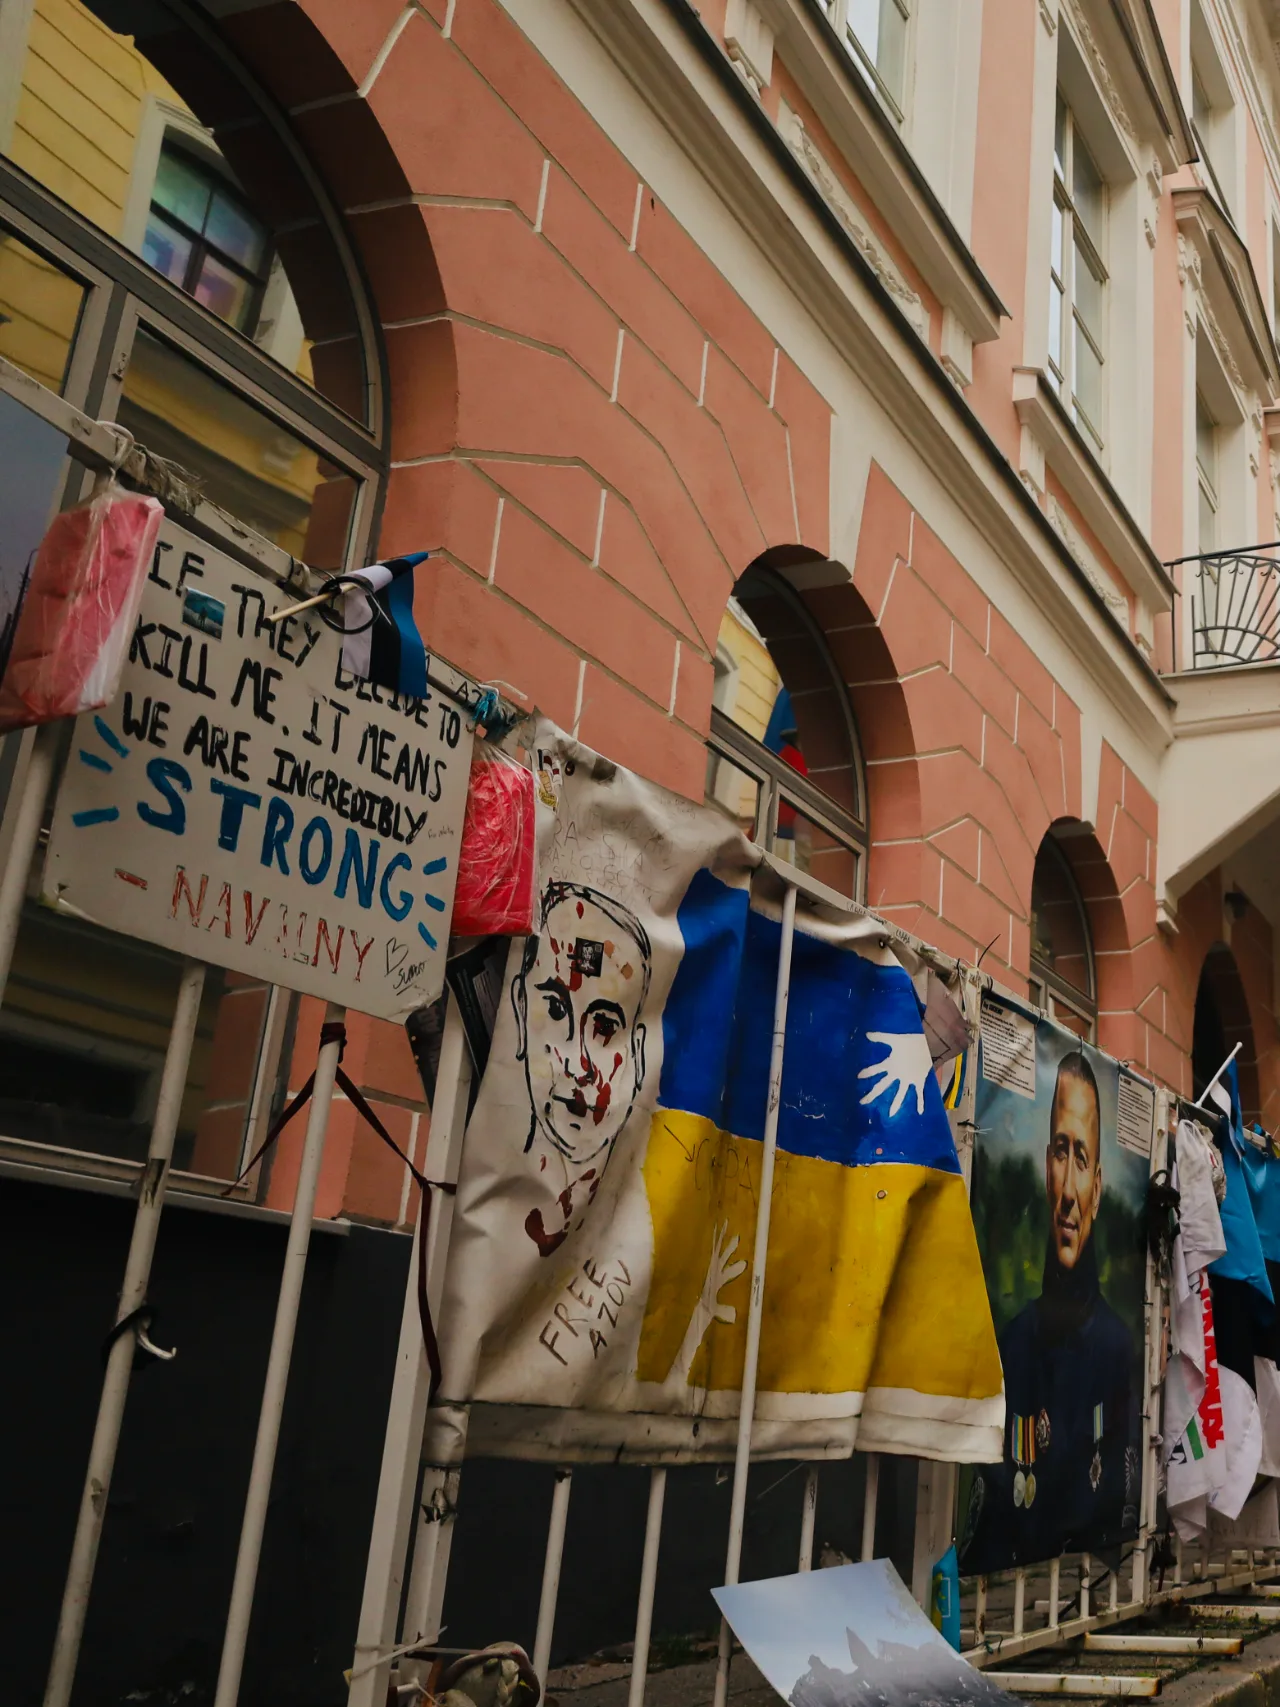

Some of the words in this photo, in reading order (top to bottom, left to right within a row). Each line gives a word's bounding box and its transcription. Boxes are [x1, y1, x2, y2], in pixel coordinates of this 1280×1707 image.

[129, 614, 217, 700] KILL
[303, 694, 350, 754] IT
[358, 721, 447, 802] MEANS
[148, 541, 205, 597] IF
[231, 583, 321, 668] THEY
[438, 702, 461, 749] TO
[123, 691, 171, 748] WE
[183, 715, 251, 782] ARE
[267, 747, 429, 845] INCREDIBLY
[137, 757, 414, 922] STRONG
[538, 1256, 608, 1366] FREE
[588, 1259, 632, 1360] AZOV
